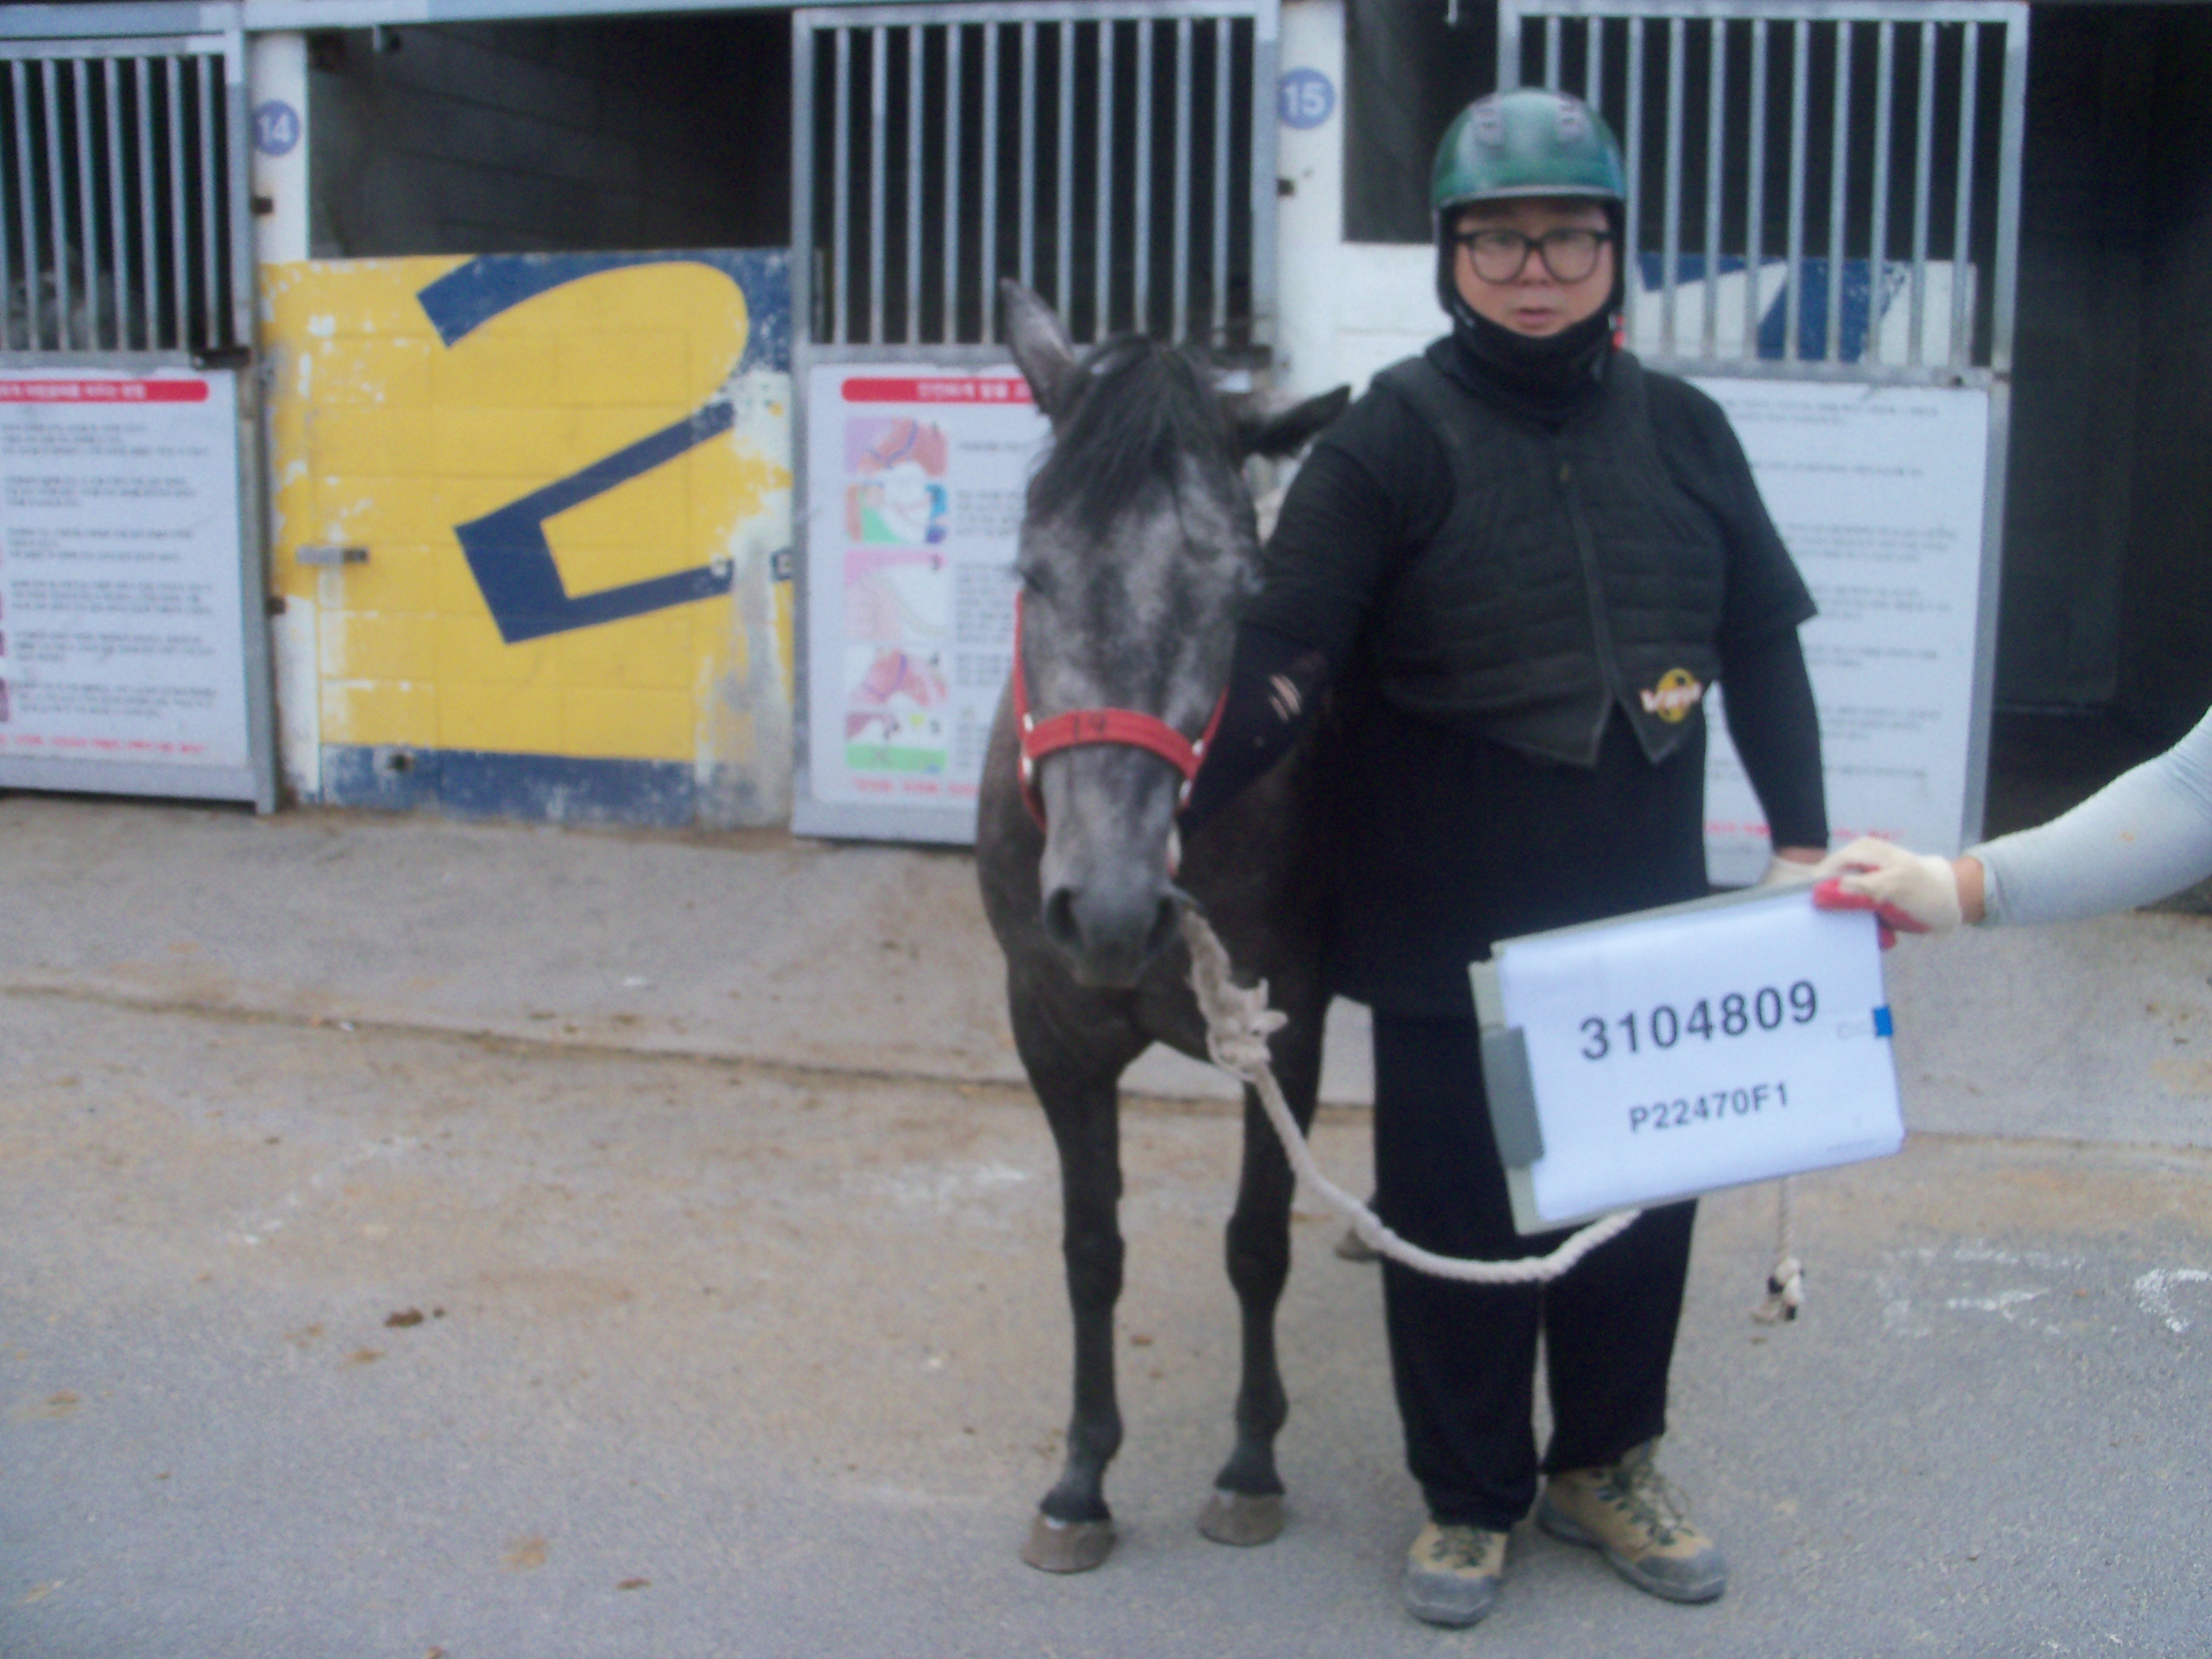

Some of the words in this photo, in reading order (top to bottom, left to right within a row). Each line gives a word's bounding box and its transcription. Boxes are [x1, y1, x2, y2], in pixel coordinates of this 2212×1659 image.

[1287, 81, 1325, 116] 15
[258, 113, 289, 145] 14
[1580, 981, 1817, 1060] 3104809
[1629, 1081, 1787, 1133] P22470F1
